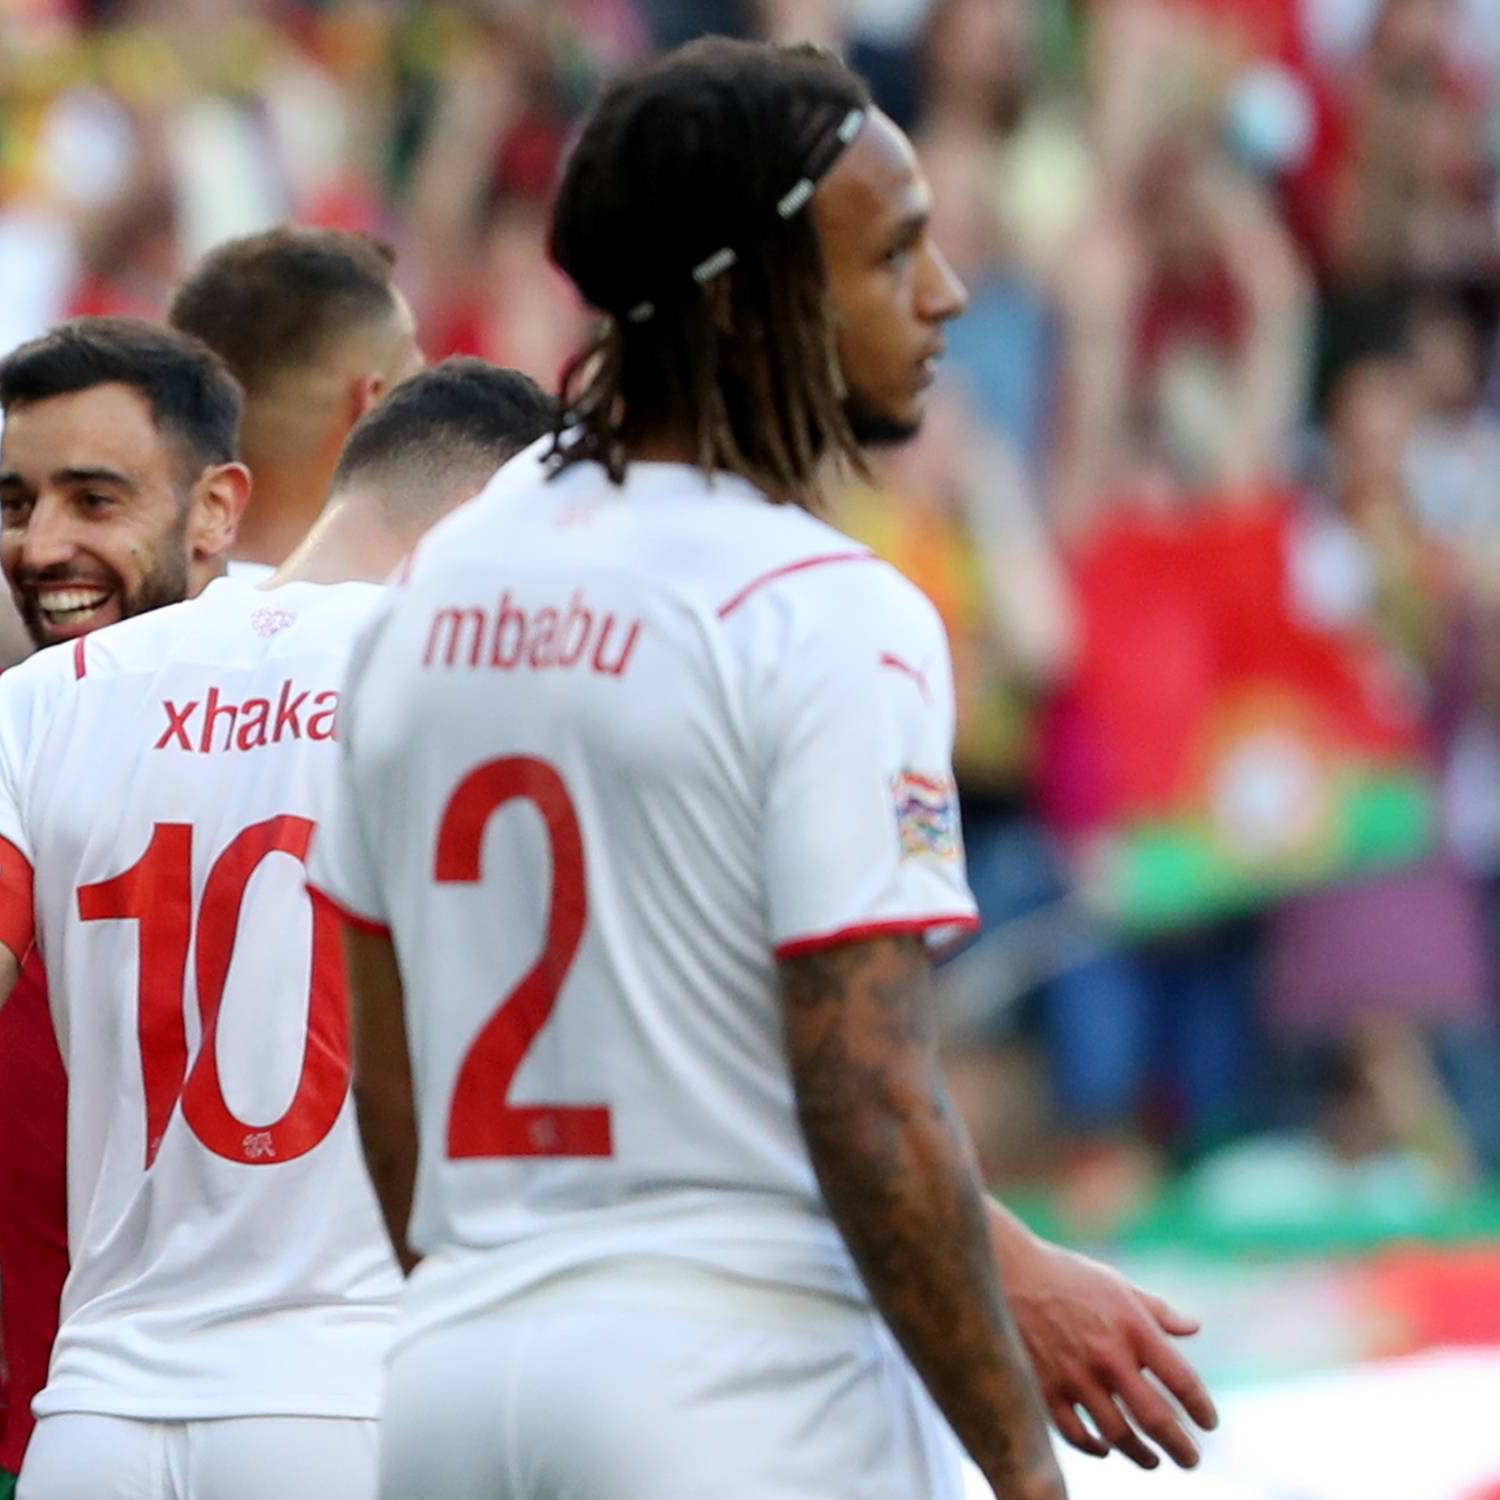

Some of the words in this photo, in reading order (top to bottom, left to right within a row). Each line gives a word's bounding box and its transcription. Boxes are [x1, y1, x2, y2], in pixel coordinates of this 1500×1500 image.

[154, 678, 339, 753] xhaka
[422, 587, 642, 677] mbabu
[77, 814, 351, 1172] 10
[432, 753, 613, 1159] 2
